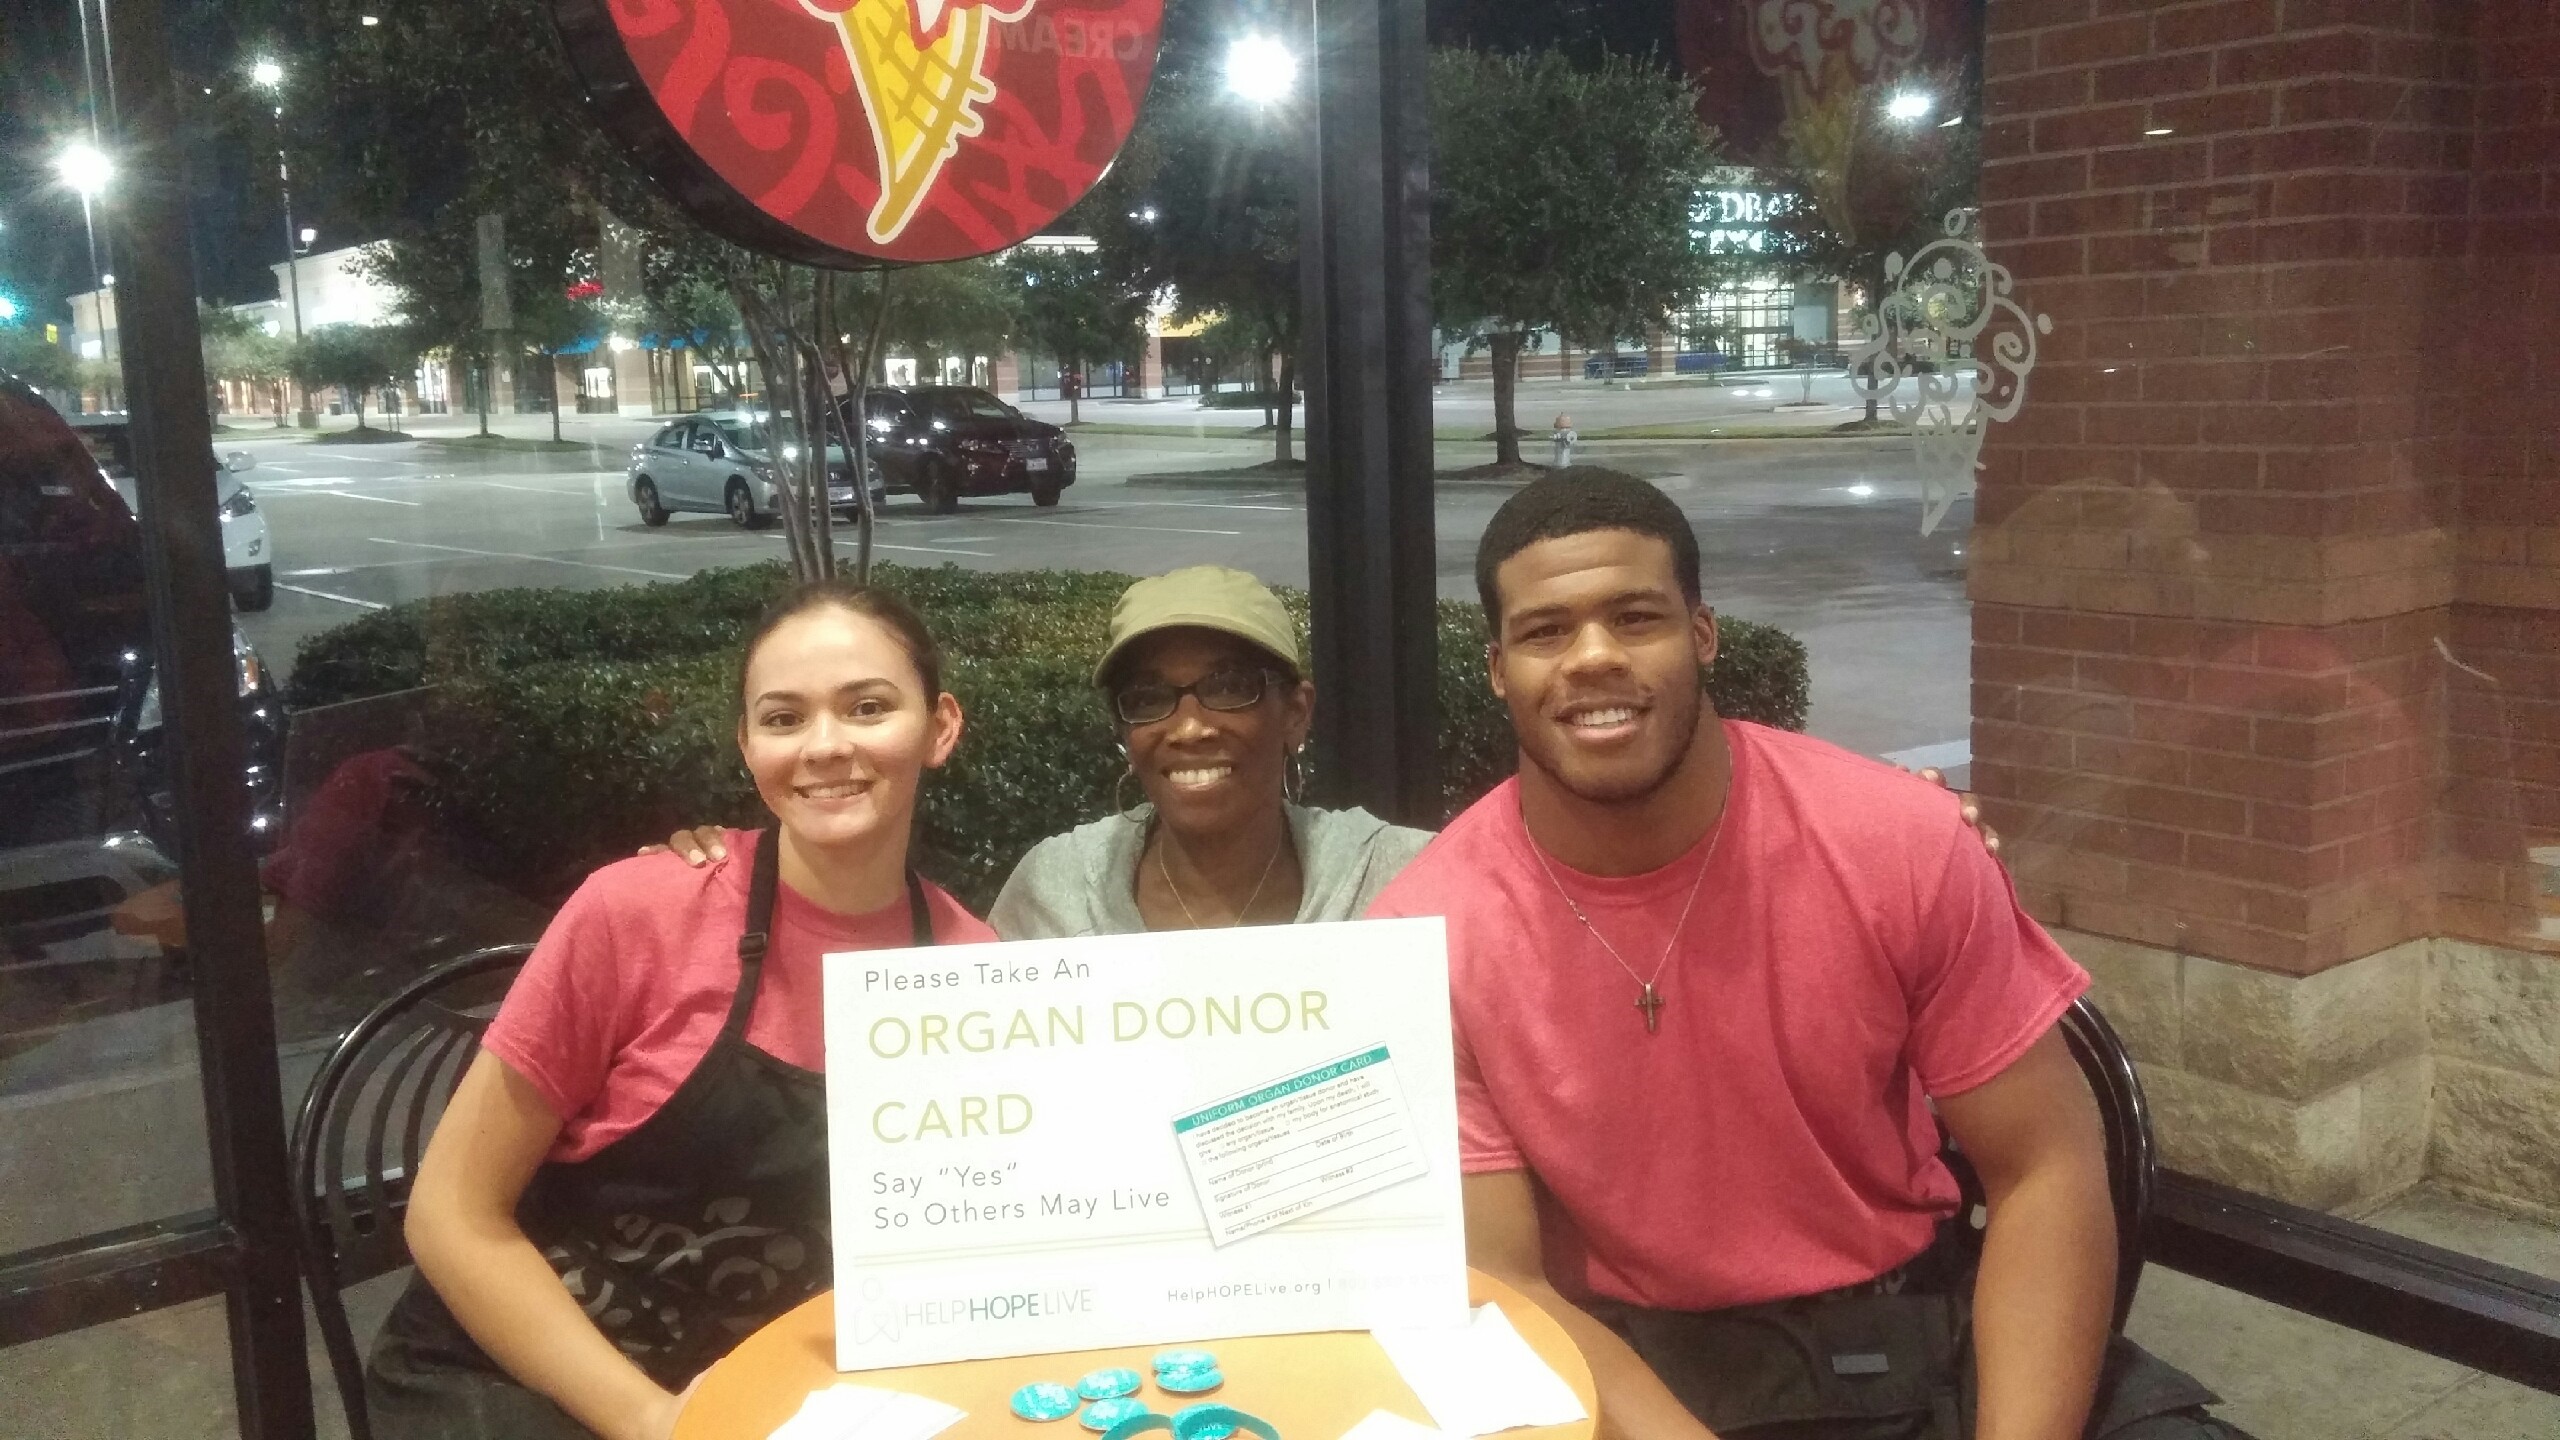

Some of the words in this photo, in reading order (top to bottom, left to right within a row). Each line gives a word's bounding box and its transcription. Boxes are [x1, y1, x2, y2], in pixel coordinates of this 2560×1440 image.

[865, 968, 960, 992] Please
[974, 961, 1040, 985] Take
[1053, 958, 1091, 980] An
[869, 1004, 1084, 1059] ORGAN
[1113, 990, 1330, 1042] DONOR
[1191, 1101, 1245, 1125] UNIFORM
[1247, 1084, 1290, 1105] ORGAN
[1292, 1067, 1337, 1089] DONOR
[1339, 1054, 1372, 1072] CARD
[872, 1093, 1033, 1144] CARD
[873, 1171, 922, 1198] Say
[939, 1162, 1017, 1188] "Yes"
[874, 1207, 909, 1229] So
[924, 1199, 1025, 1225] Others
[1041, 1193, 1098, 1219] May
[1113, 1188, 1169, 1210] Live
[1168, 1282, 1321, 1304] HelpHOPELive.org
